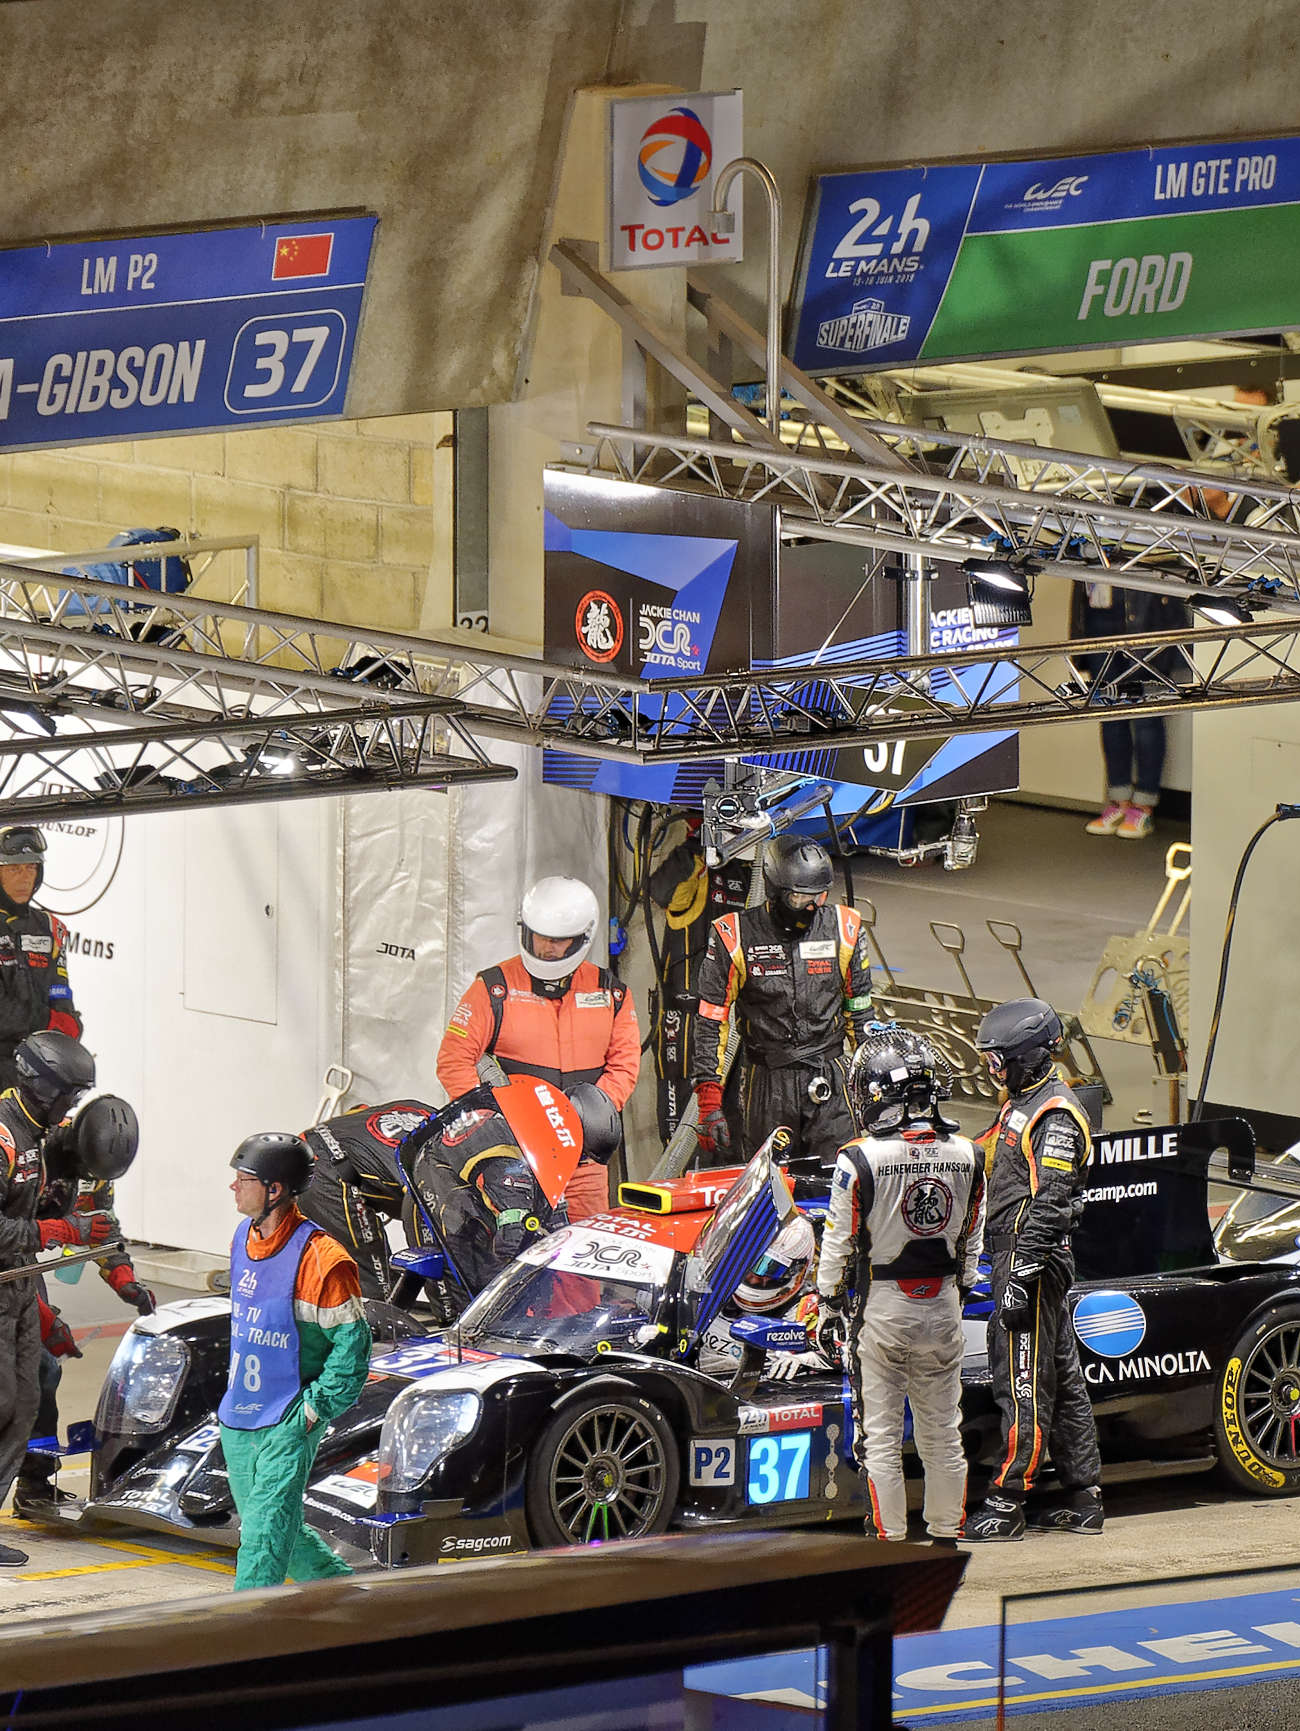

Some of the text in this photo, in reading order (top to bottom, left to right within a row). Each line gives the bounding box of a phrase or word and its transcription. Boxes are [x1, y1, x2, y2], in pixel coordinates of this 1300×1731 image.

[1155, 154, 1277, 200] LM GTE PRO
[620, 224, 730, 252] TOTAL
[832, 193, 930, 258] 24h
[81, 253, 156, 296] LM P2
[825, 256, 920, 278] LE MANS
[1077, 252, 1192, 320] FORD
[819, 310, 909, 351] SUPERFINALE
[242, 326, 330, 398] 37
[639, 604, 700, 624] JACKIE CHAN
[930, 607, 970, 628] ACKIE
[942, 626, 998, 645] RACING
[639, 652, 700, 671] JOTA Sport
[66, 931, 114, 959] Mans
[376, 942, 416, 961] JOTA
[1100, 1133, 1178, 1165] MILLE
[246, 1306, 261, 1324] TV
[248, 1327, 290, 1349] TRACK
[767, 1329, 805, 1342] rezolve
[1119, 1350, 1212, 1381] MINOLTA
[774, 1408, 819, 1422] TOTAL
[1224, 1364, 1262, 1475] DUNLOP
[695, 1447, 730, 1479] P2
[749, 1432, 810, 1504] 37
[456, 1535, 512, 1551] sagcom
